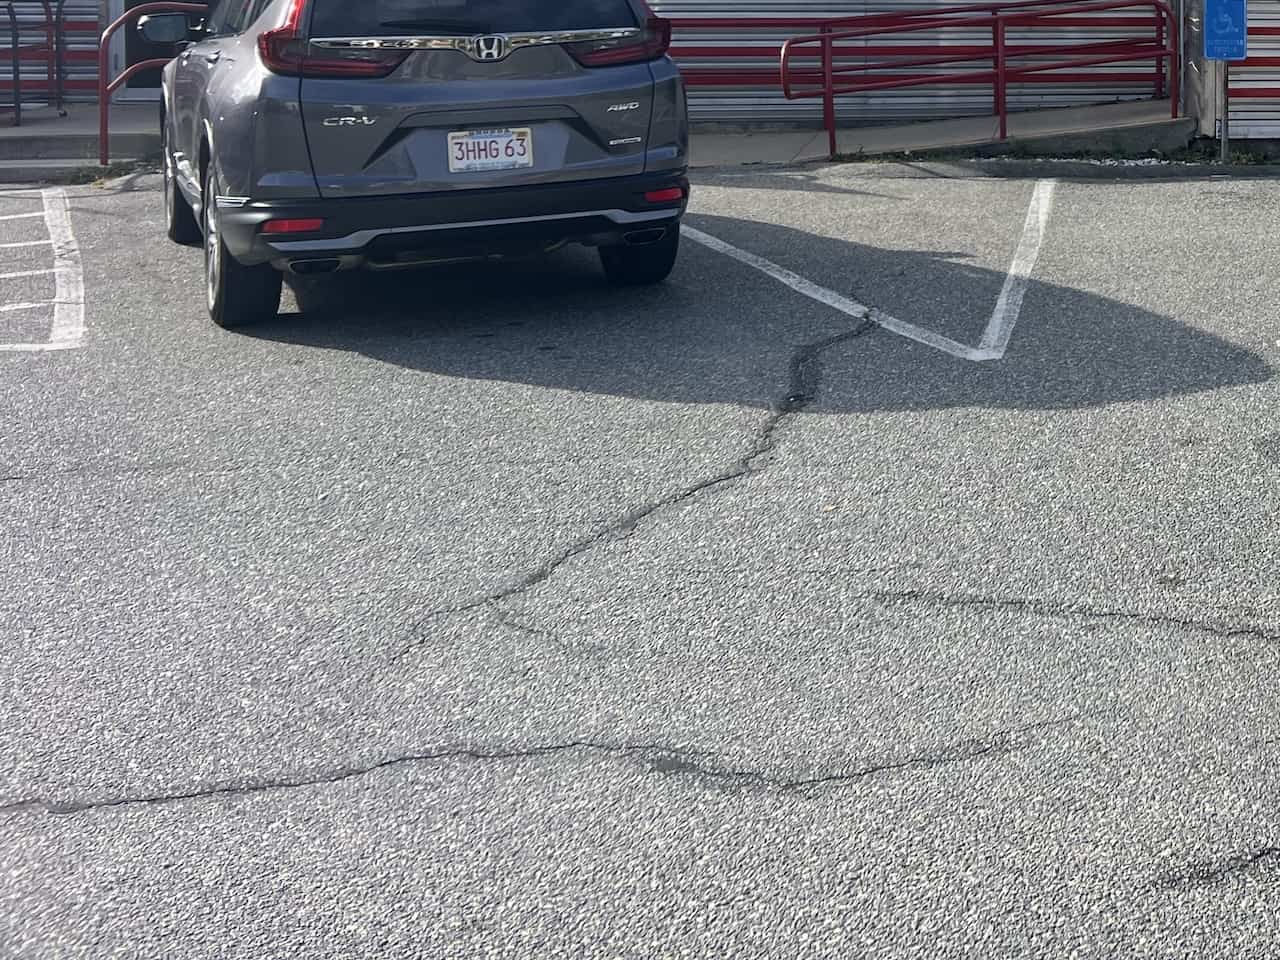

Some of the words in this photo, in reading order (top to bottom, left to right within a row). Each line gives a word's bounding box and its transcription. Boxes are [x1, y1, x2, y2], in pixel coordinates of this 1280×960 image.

[322, 115, 378, 127] CR-V
[453, 139, 500, 161] 3HHG
[504, 137, 527, 158] 63
